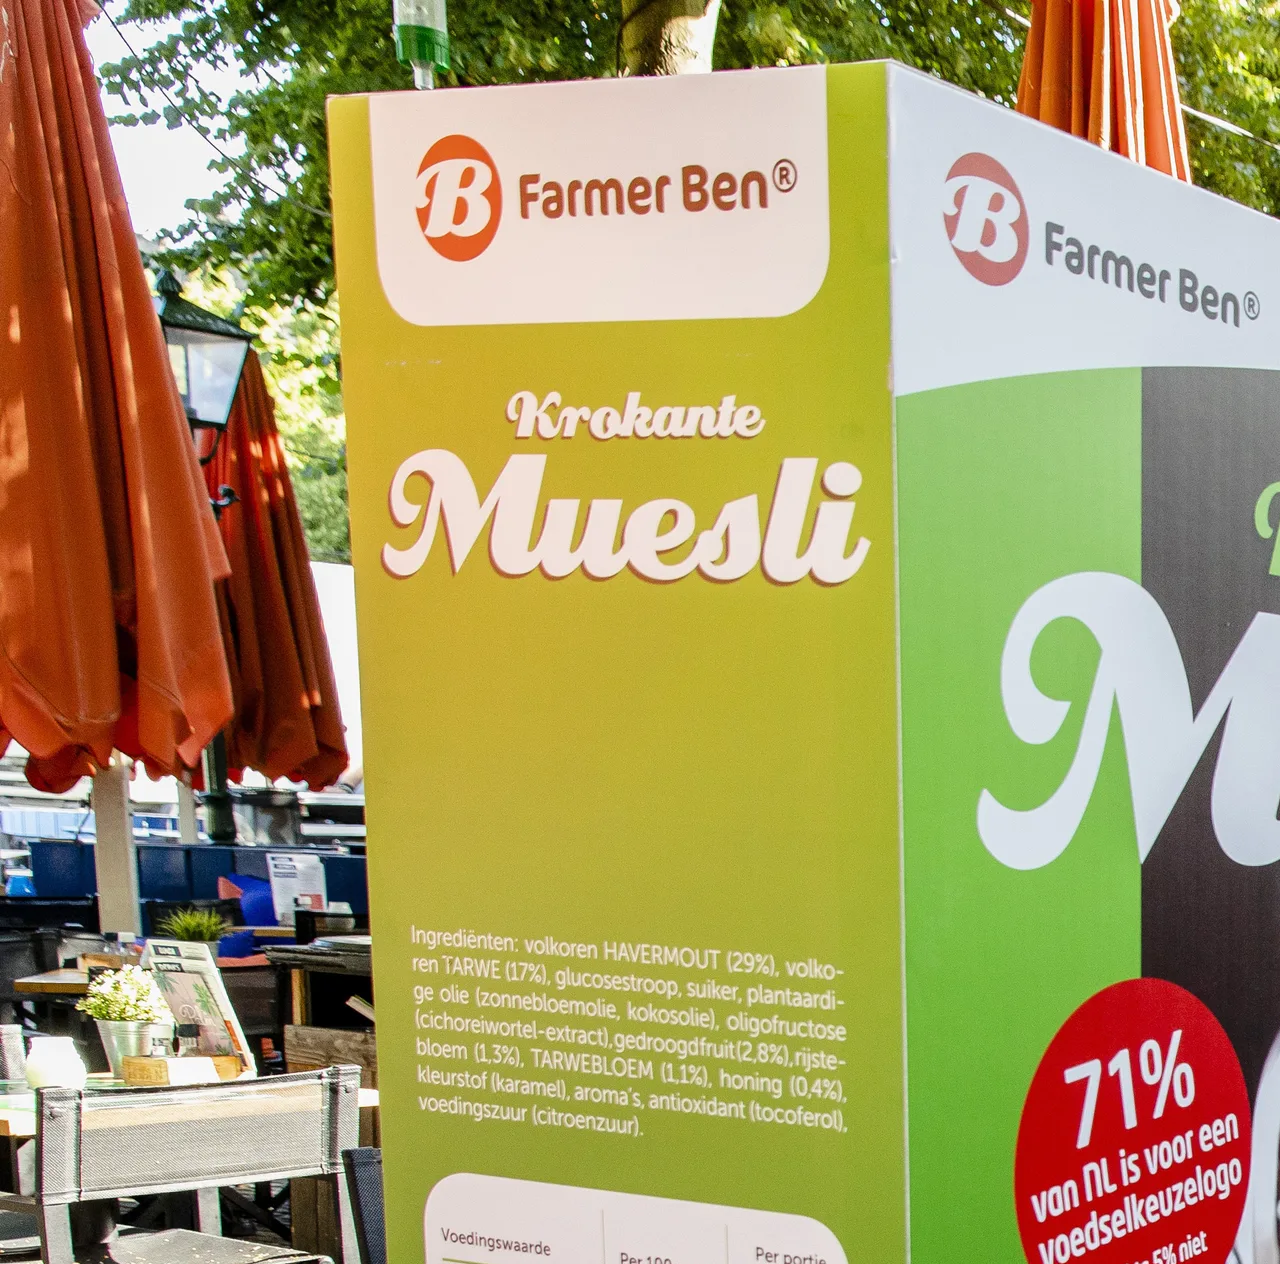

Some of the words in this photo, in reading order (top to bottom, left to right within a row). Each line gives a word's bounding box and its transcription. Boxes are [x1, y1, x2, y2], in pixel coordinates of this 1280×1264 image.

[519, 170, 672, 220] Farmer
[1044, 222, 1170, 301] Farmer
[507, 390, 766, 441] Krokante
[381, 449, 871, 588] Muesli
[411, 925, 519, 952] Ingrediënten:
[525, 936, 597, 959] volkoren
[604, 941, 721, 969] HAVERMOUT
[727, 951, 779, 977] (29%),
[786, 959, 844, 980] volko-
[412, 957, 438, 973] ren
[442, 955, 500, 979] TARWE
[505, 961, 551, 986] (17%),
[555, 966, 682, 1000] glucosestroop,
[687, 979, 742, 1004] suiker,
[747, 984, 845, 1010] plantaardi-
[414, 985, 433, 1005] ge
[440, 984, 469, 1004] olie
[476, 987, 621, 1021] (zonnebloemolie,
[627, 1001, 719, 1031] kokosolie),
[726, 1012, 846, 1041] oligofructose
[416, 1037, 467, 1060] bloem
[474, 1043, 524, 1068] (1,3%),
[531, 1048, 654, 1080] TARWEBLOEM
[660, 1062, 712, 1088] (1,1%),
[719, 1068, 782, 1099] honing
[790, 1075, 847, 1104] (0,4%),
[1064, 1030, 1195, 1149] 71%
[417, 1064, 487, 1089] kleurstof
[491, 1072, 570, 1101] (karamel),
[574, 1085, 644, 1110] aroma's,
[650, 1093, 746, 1119] antioxidant
[750, 1100, 848, 1133] (tocoferol),
[418, 1096, 527, 1121] voedingszuur
[532, 1104, 644, 1137] (citroenzuur).
[1031, 1179, 1079, 1223] van
[1082, 1157, 1118, 1202] NL
[1119, 1149, 1141, 1186] is
[1144, 1130, 1193, 1175] voor
[1199, 1113, 1239, 1152] een
[441, 1227, 551, 1257] Voedingswaarde
[755, 1247, 779, 1263] Per
[1179, 1231, 1208, 1262] niet
